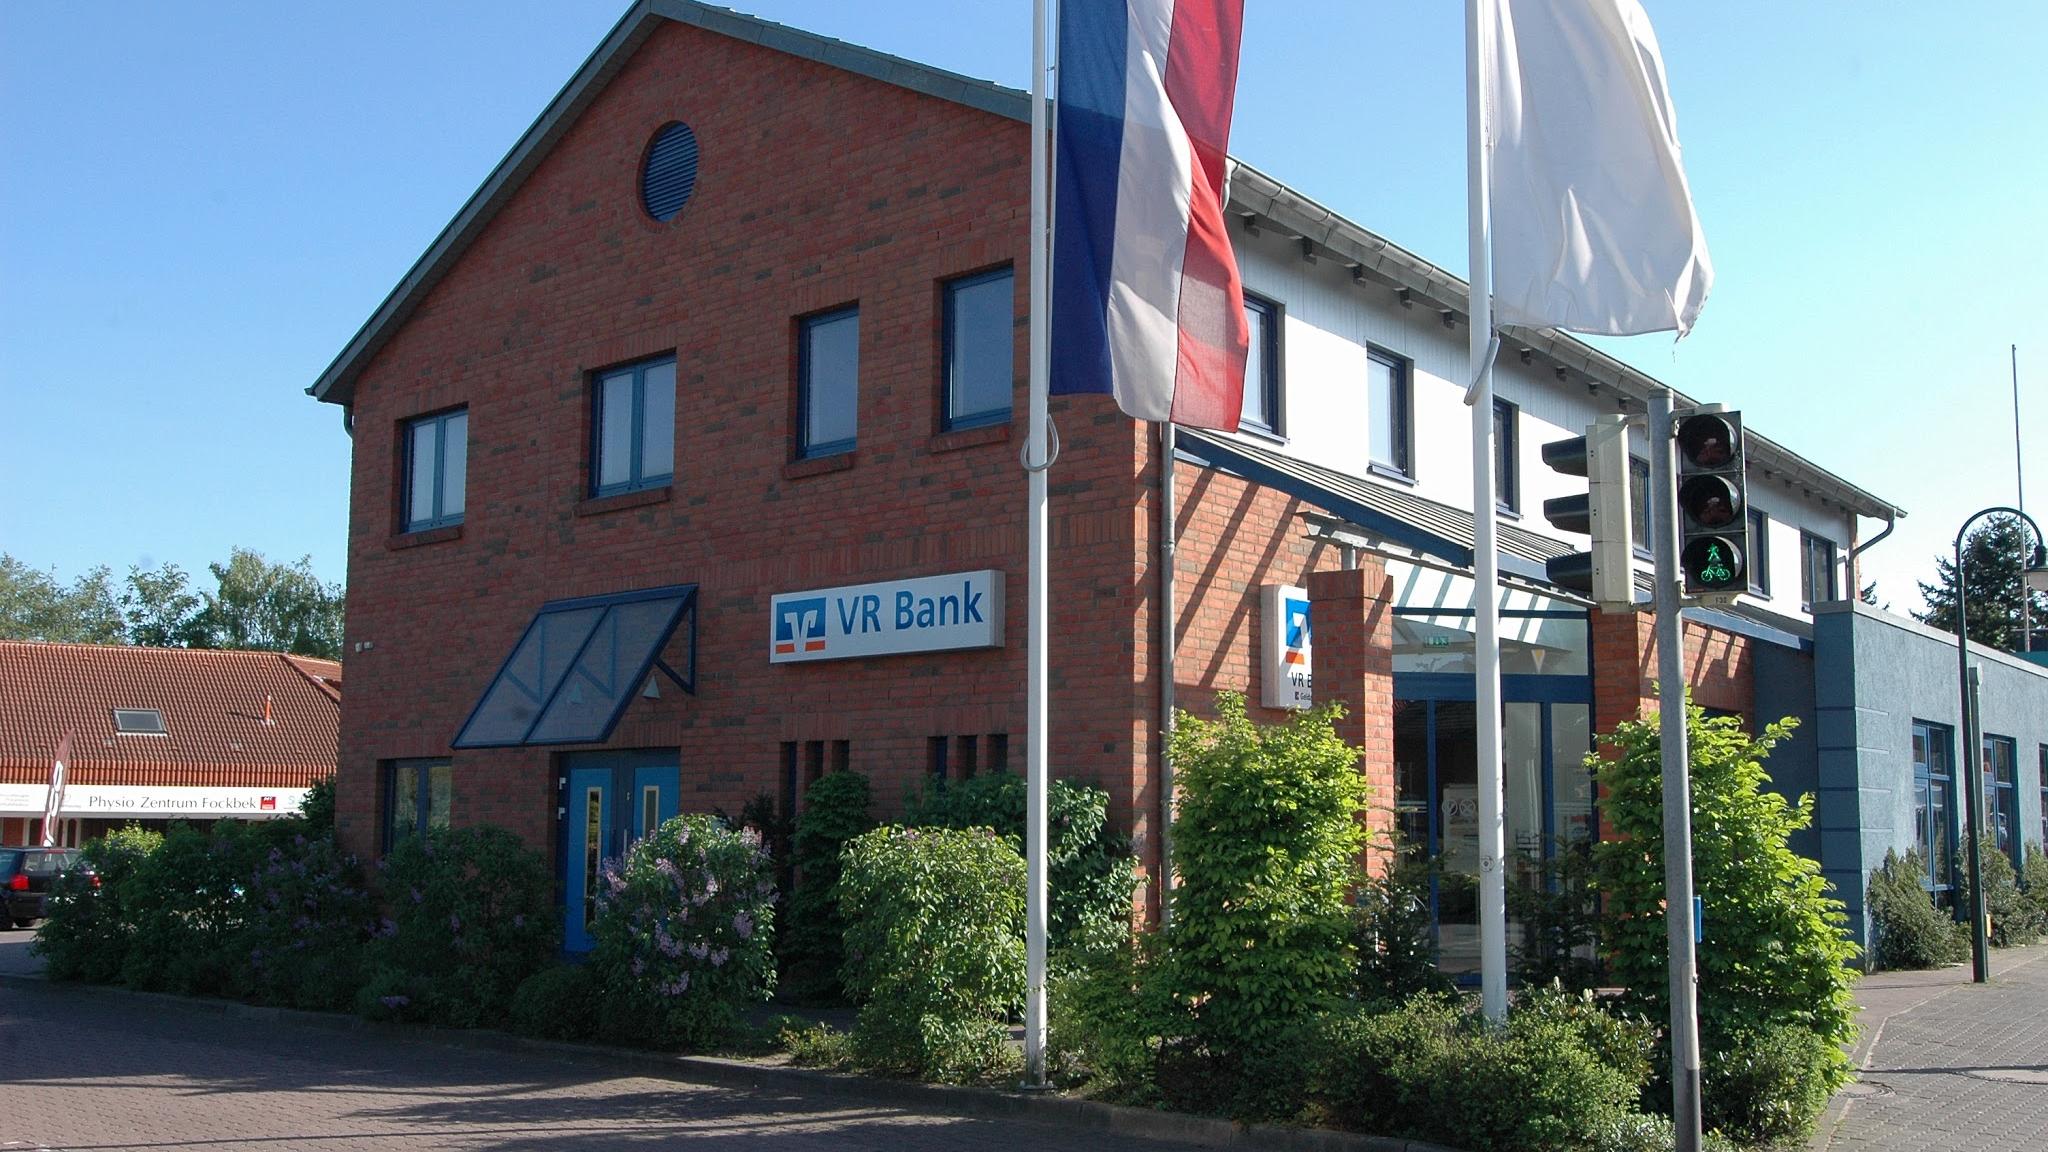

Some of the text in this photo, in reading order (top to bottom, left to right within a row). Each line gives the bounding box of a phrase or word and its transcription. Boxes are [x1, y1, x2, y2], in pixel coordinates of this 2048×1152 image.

[837, 580, 984, 635] VR Bank
[1291, 672, 1304, 687] VR
[89, 795, 135, 811] Physio
[140, 796, 198, 809] Zentrum
[202, 797, 257, 809] Fockbek
